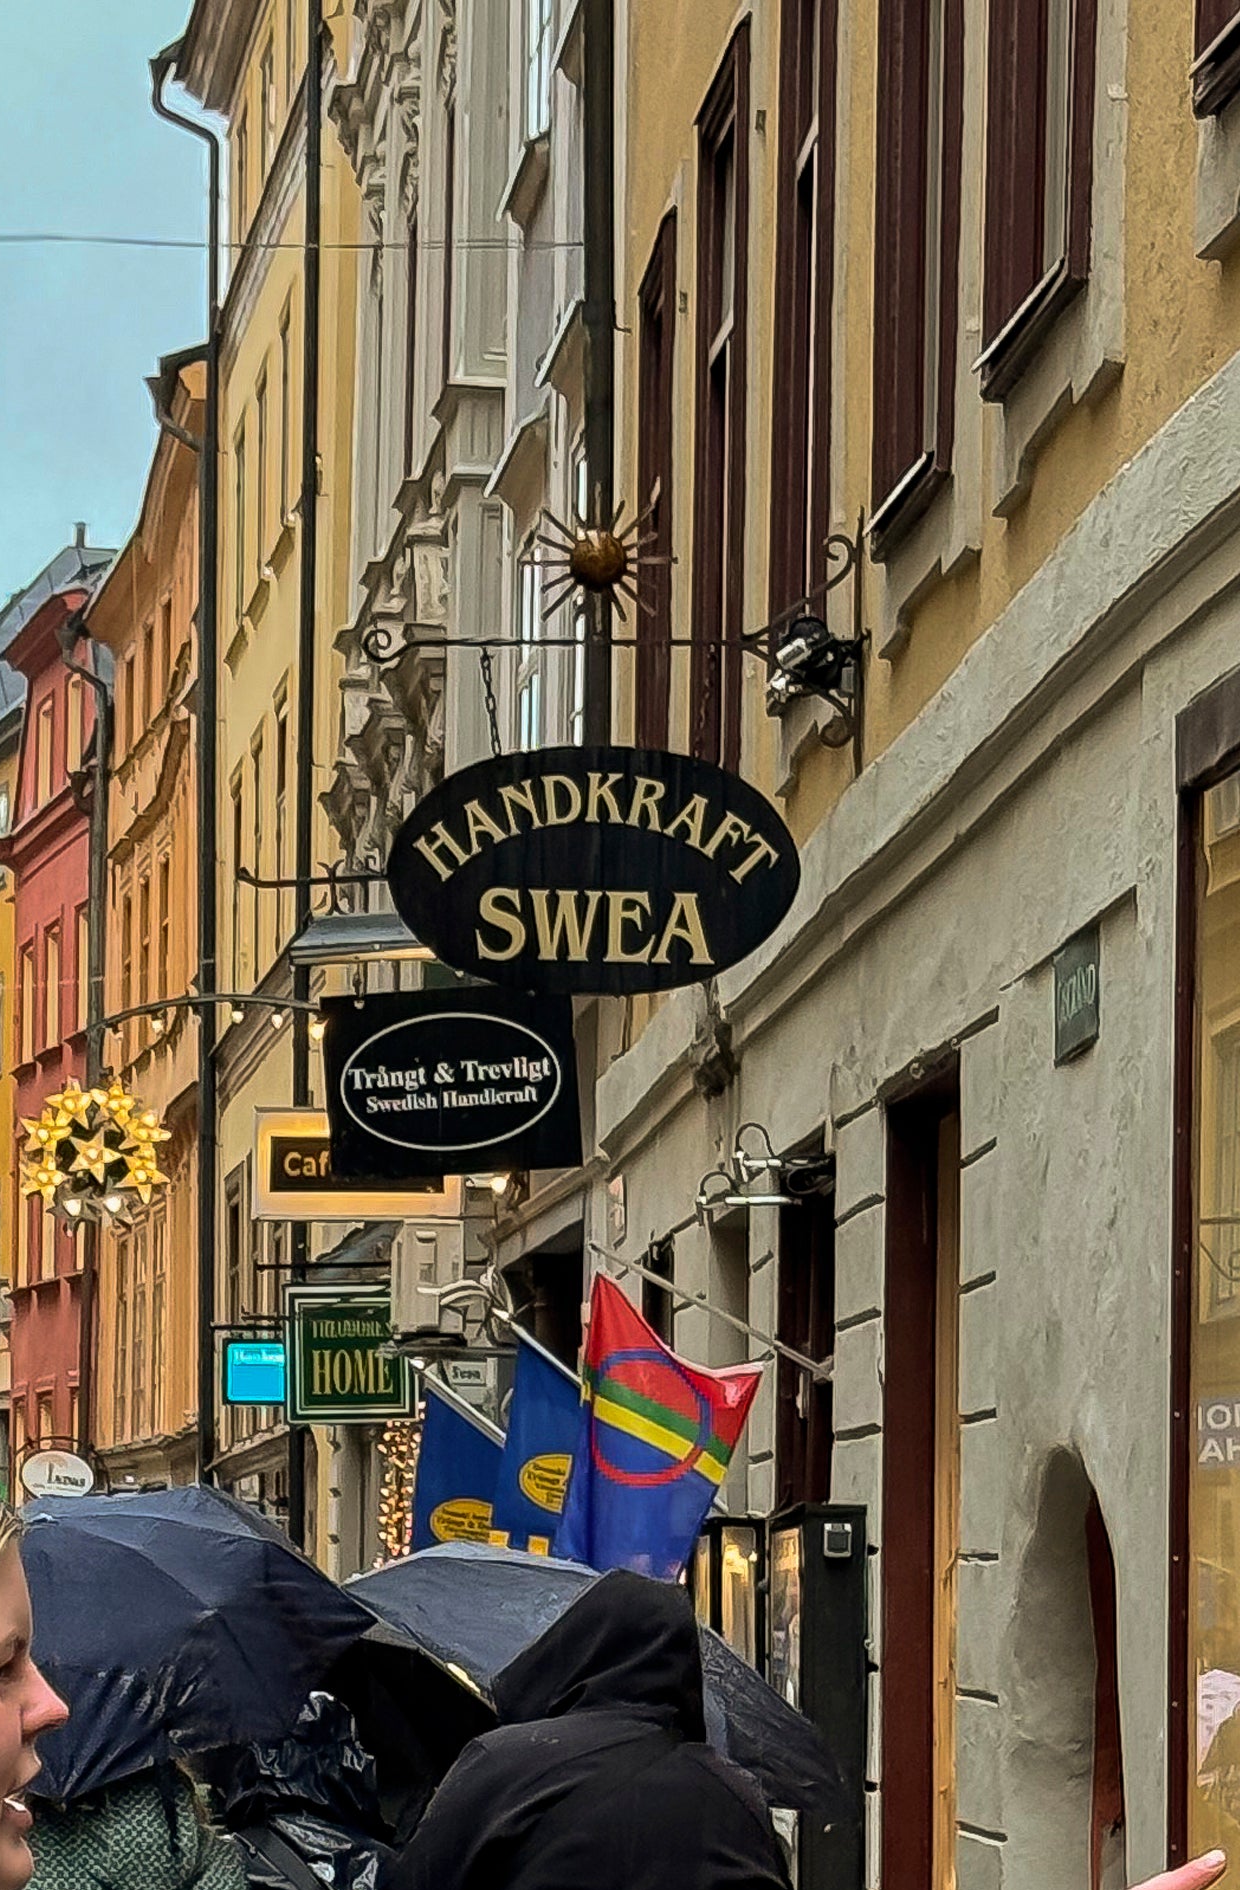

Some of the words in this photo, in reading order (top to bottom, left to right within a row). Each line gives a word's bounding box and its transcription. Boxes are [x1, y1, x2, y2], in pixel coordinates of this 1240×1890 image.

[412, 772, 781, 885] HANDKRAFT
[474, 886, 715, 966] SWEA
[348, 1064, 427, 1092] Trångt
[433, 1061, 455, 1084] &
[460, 1055, 551, 1082] Trevligt
[366, 1092, 438, 1114] Swedish
[283, 1151, 332, 1177] Caf
[311, 1349, 394, 1396] HOME
